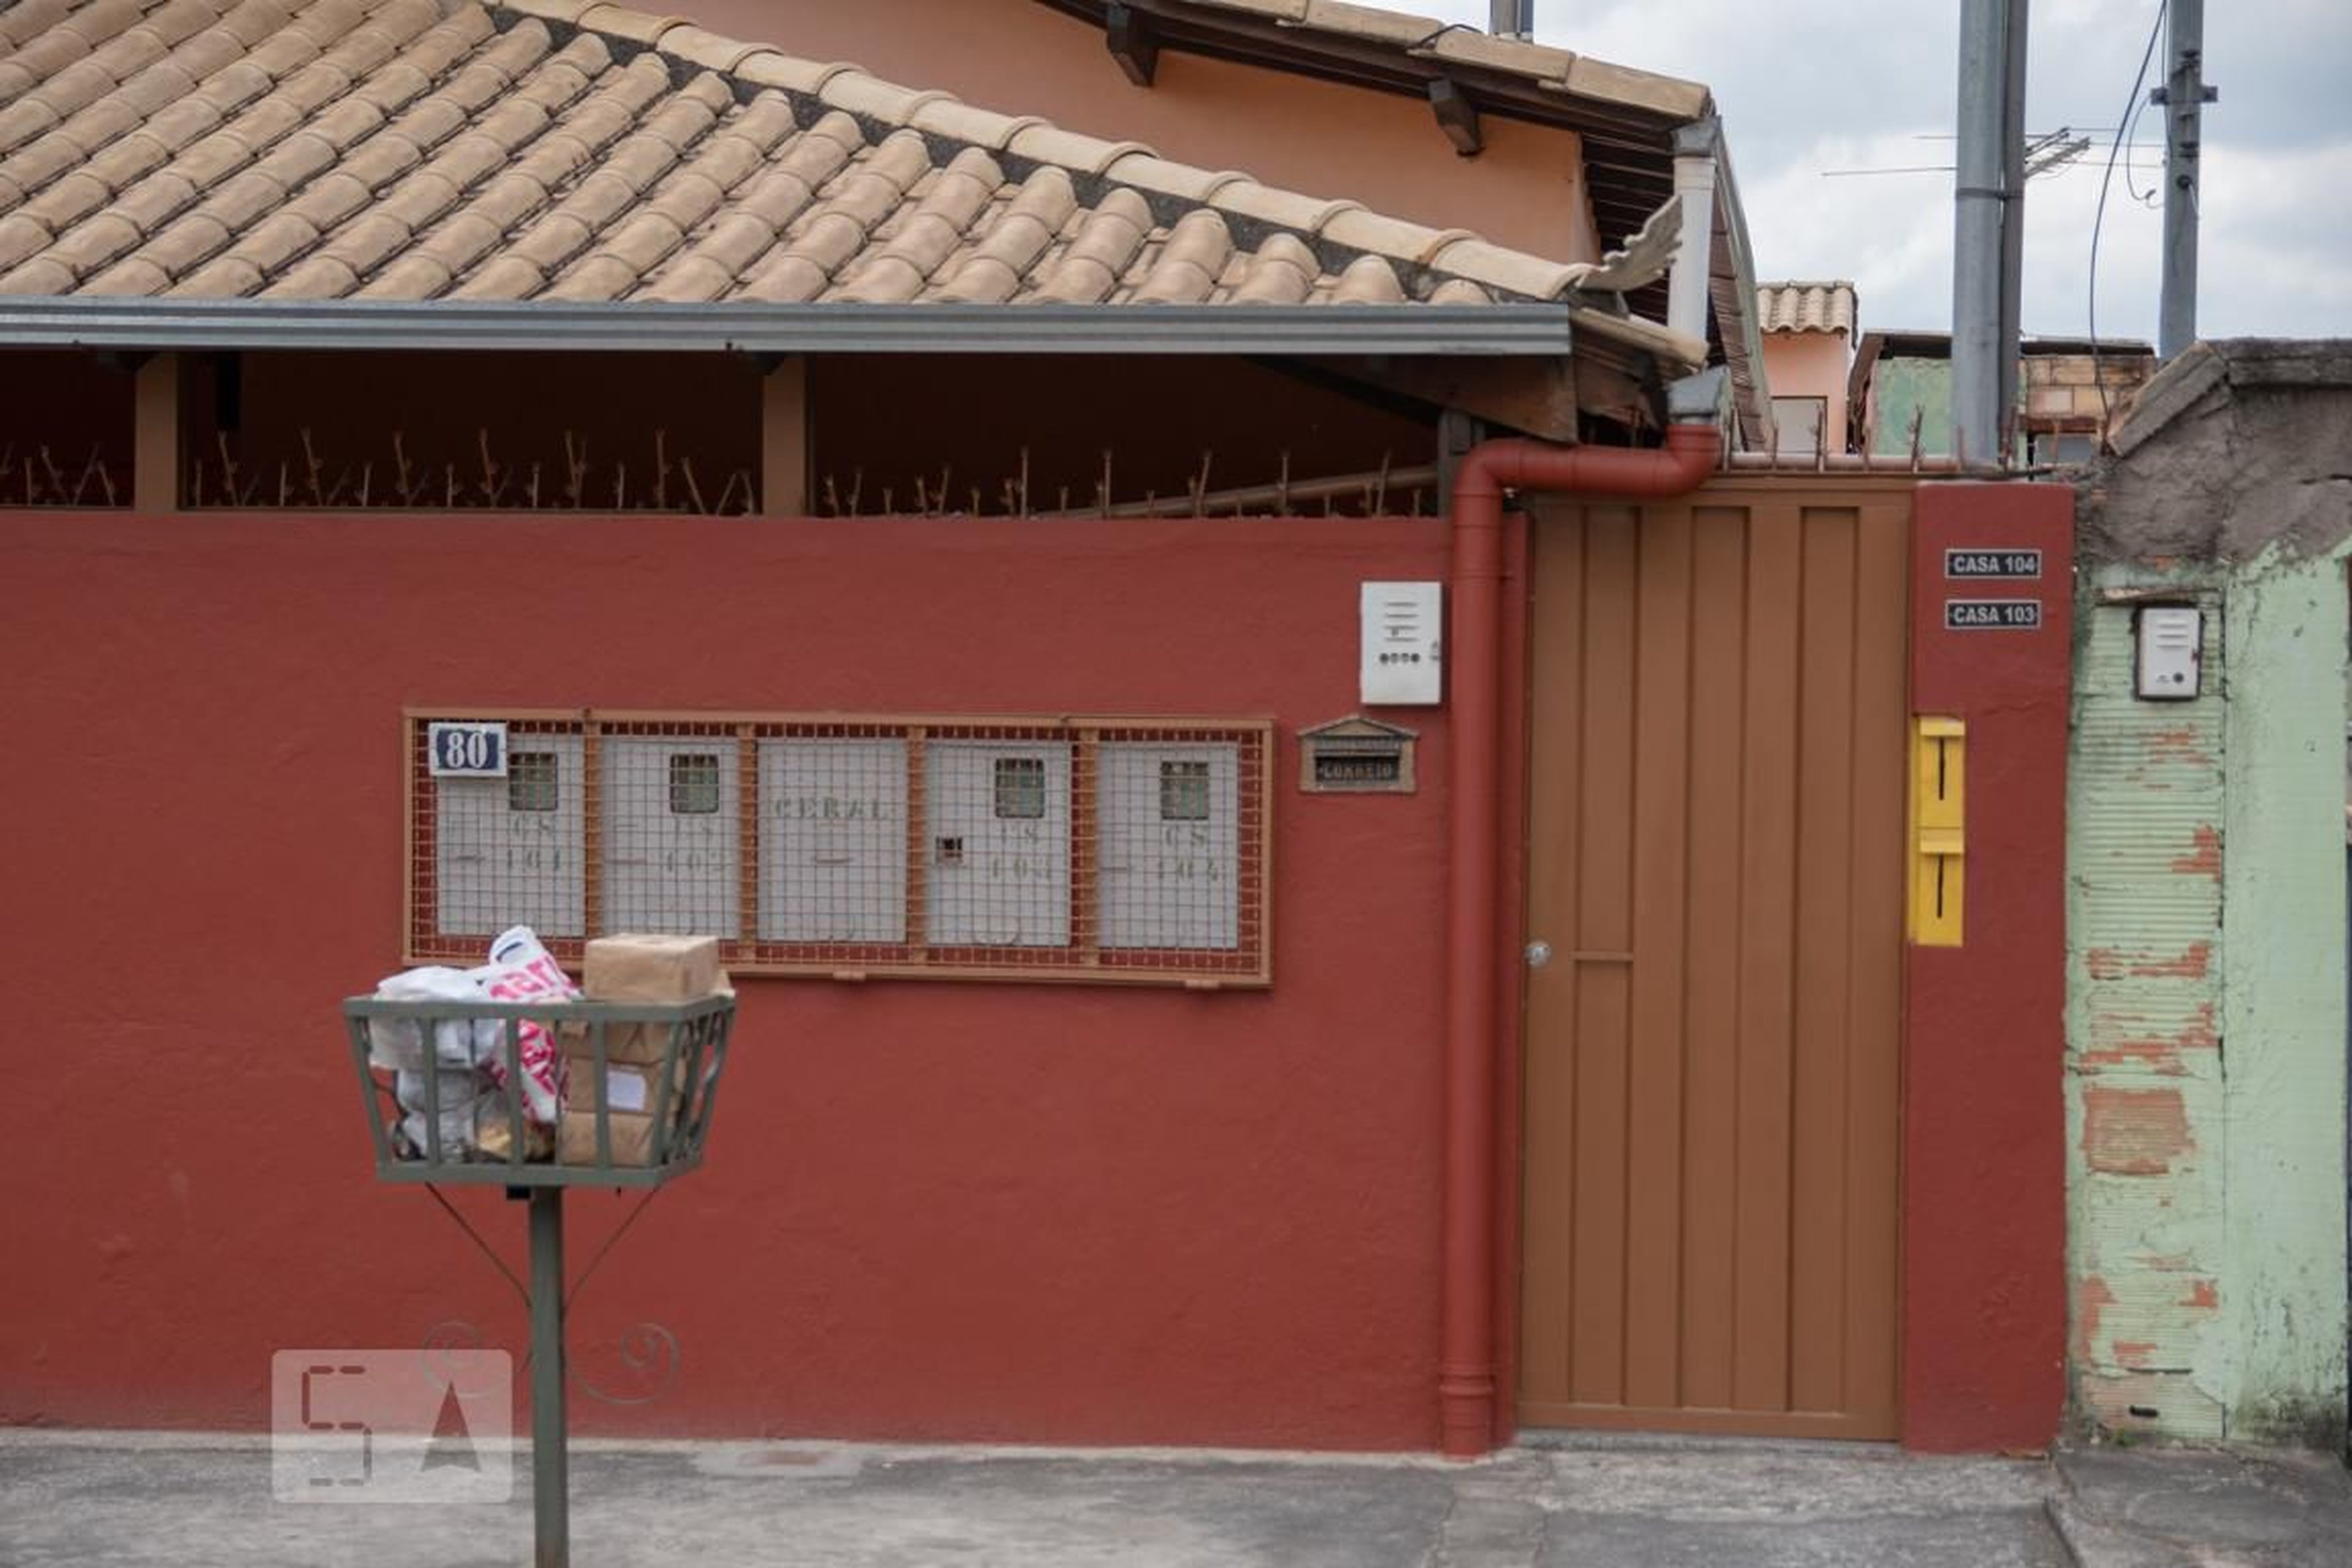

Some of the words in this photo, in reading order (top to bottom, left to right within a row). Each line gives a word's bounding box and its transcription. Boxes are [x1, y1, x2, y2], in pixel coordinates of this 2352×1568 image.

[1954, 556, 2000, 573] CASA
[2005, 556, 2035, 573] 104
[1954, 606, 1999, 624] CASA
[2005, 606, 2035, 623] 103
[447, 732, 488, 769] 80
